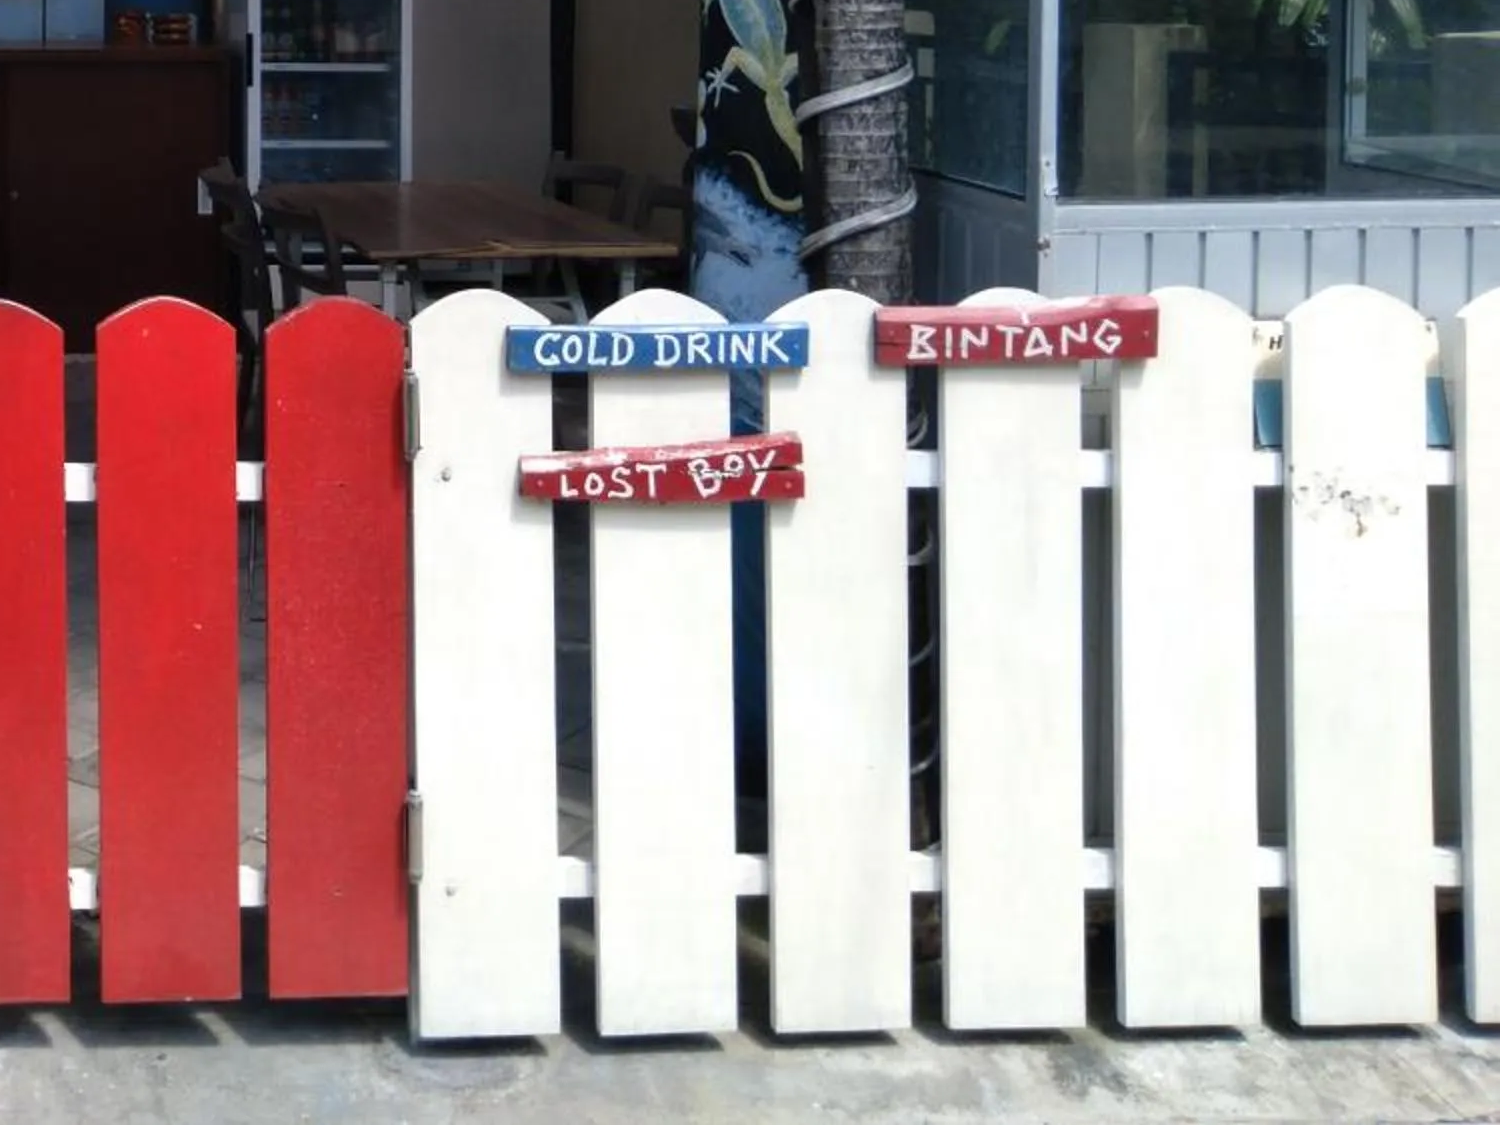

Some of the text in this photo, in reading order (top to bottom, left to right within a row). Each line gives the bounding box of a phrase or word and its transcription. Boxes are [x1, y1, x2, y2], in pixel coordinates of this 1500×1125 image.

[533, 330, 790, 366] COLD DRINK
[906, 318, 1122, 361] BINTANG
[560, 449, 777, 498] LOST BOY
